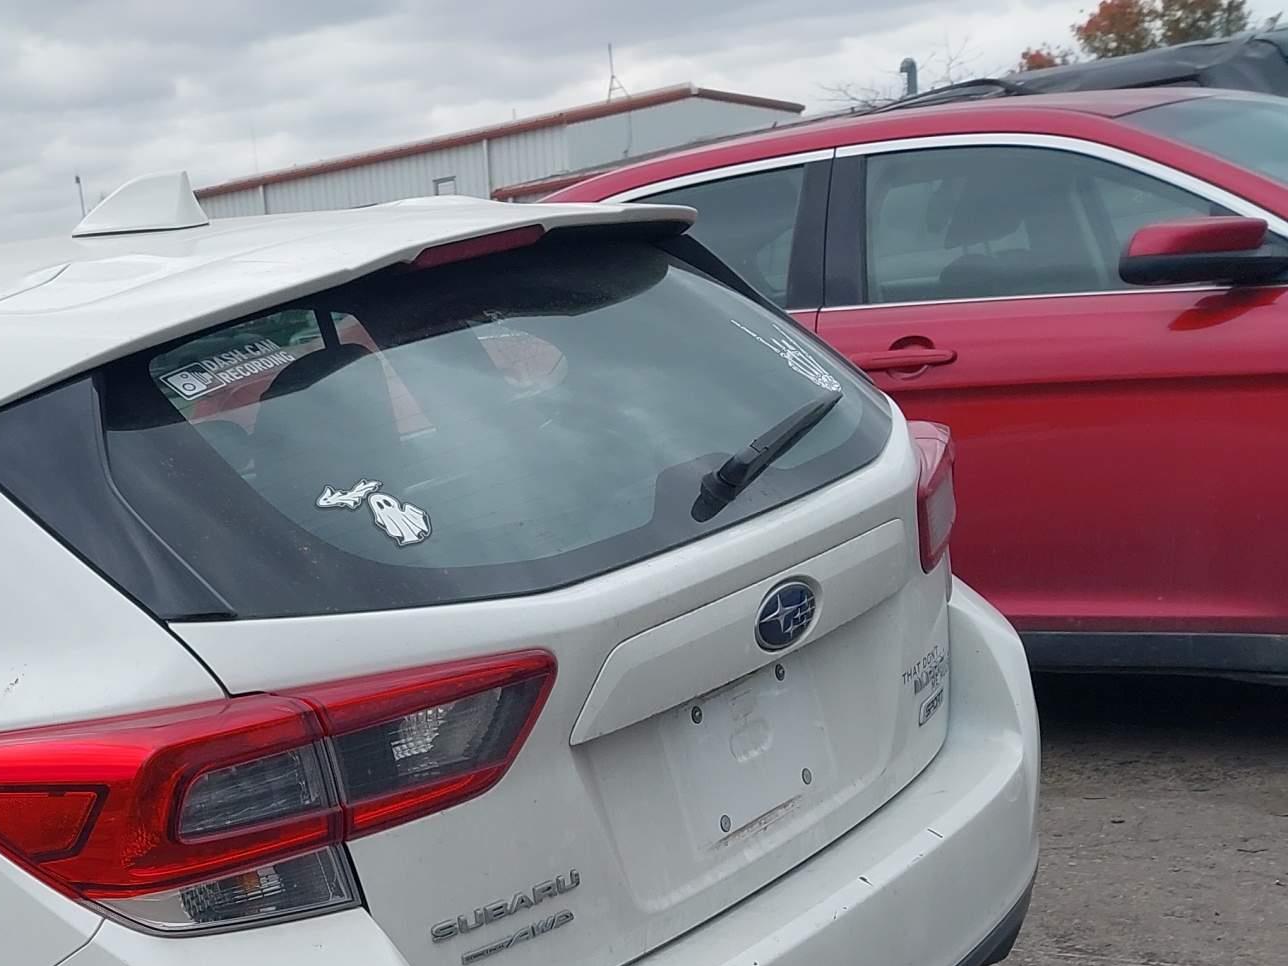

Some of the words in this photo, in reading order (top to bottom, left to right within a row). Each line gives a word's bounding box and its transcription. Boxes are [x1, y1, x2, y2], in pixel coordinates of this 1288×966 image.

[217, 350, 297, 383] RECORDING
[431, 868, 581, 942] SUBARU
[507, 909, 575, 949] AWD
